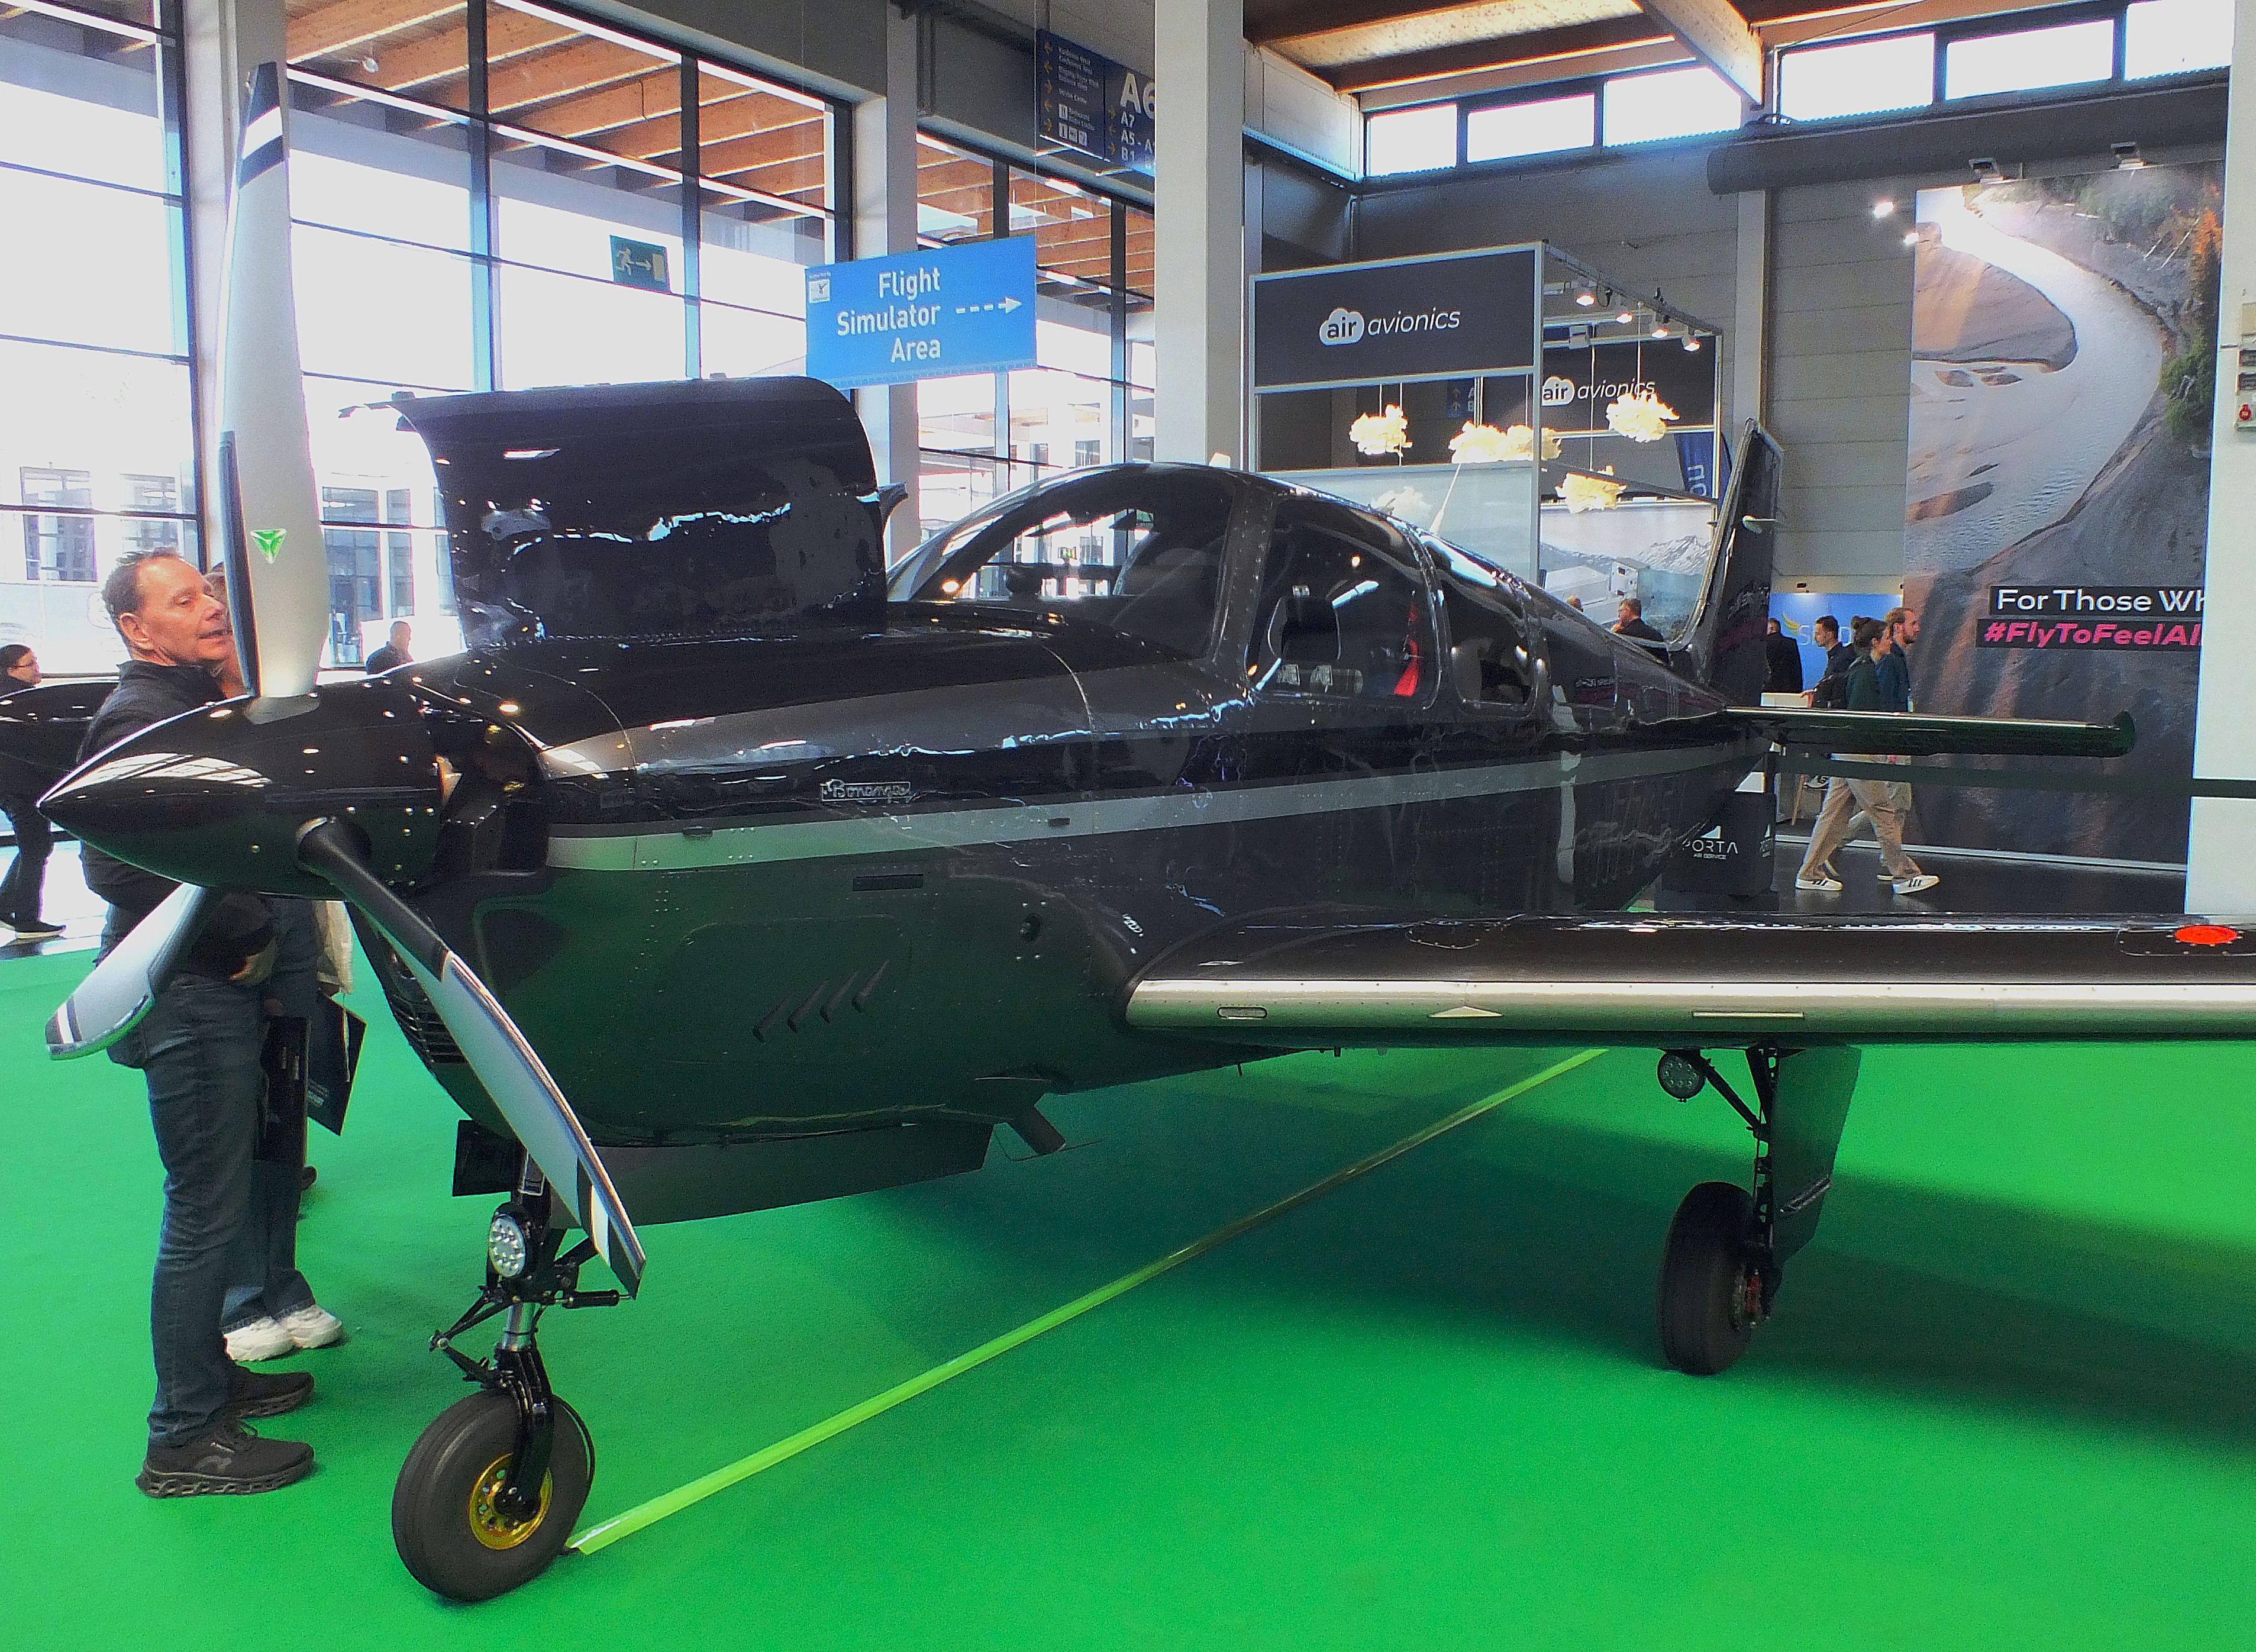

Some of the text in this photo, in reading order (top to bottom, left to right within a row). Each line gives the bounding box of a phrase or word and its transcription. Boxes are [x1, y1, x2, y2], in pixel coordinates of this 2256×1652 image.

[1120, 73, 1155, 120] A6
[1121, 111, 1135, 128] A7
[878, 267, 940, 301] Flight
[837, 305, 941, 336] Simulator
[1327, 307, 1461, 338] air avionics
[890, 338, 941, 363] Area
[1543, 378, 1655, 401] air avionics
[1997, 589, 2048, 611] For
[2052, 589, 2151, 611] Those
